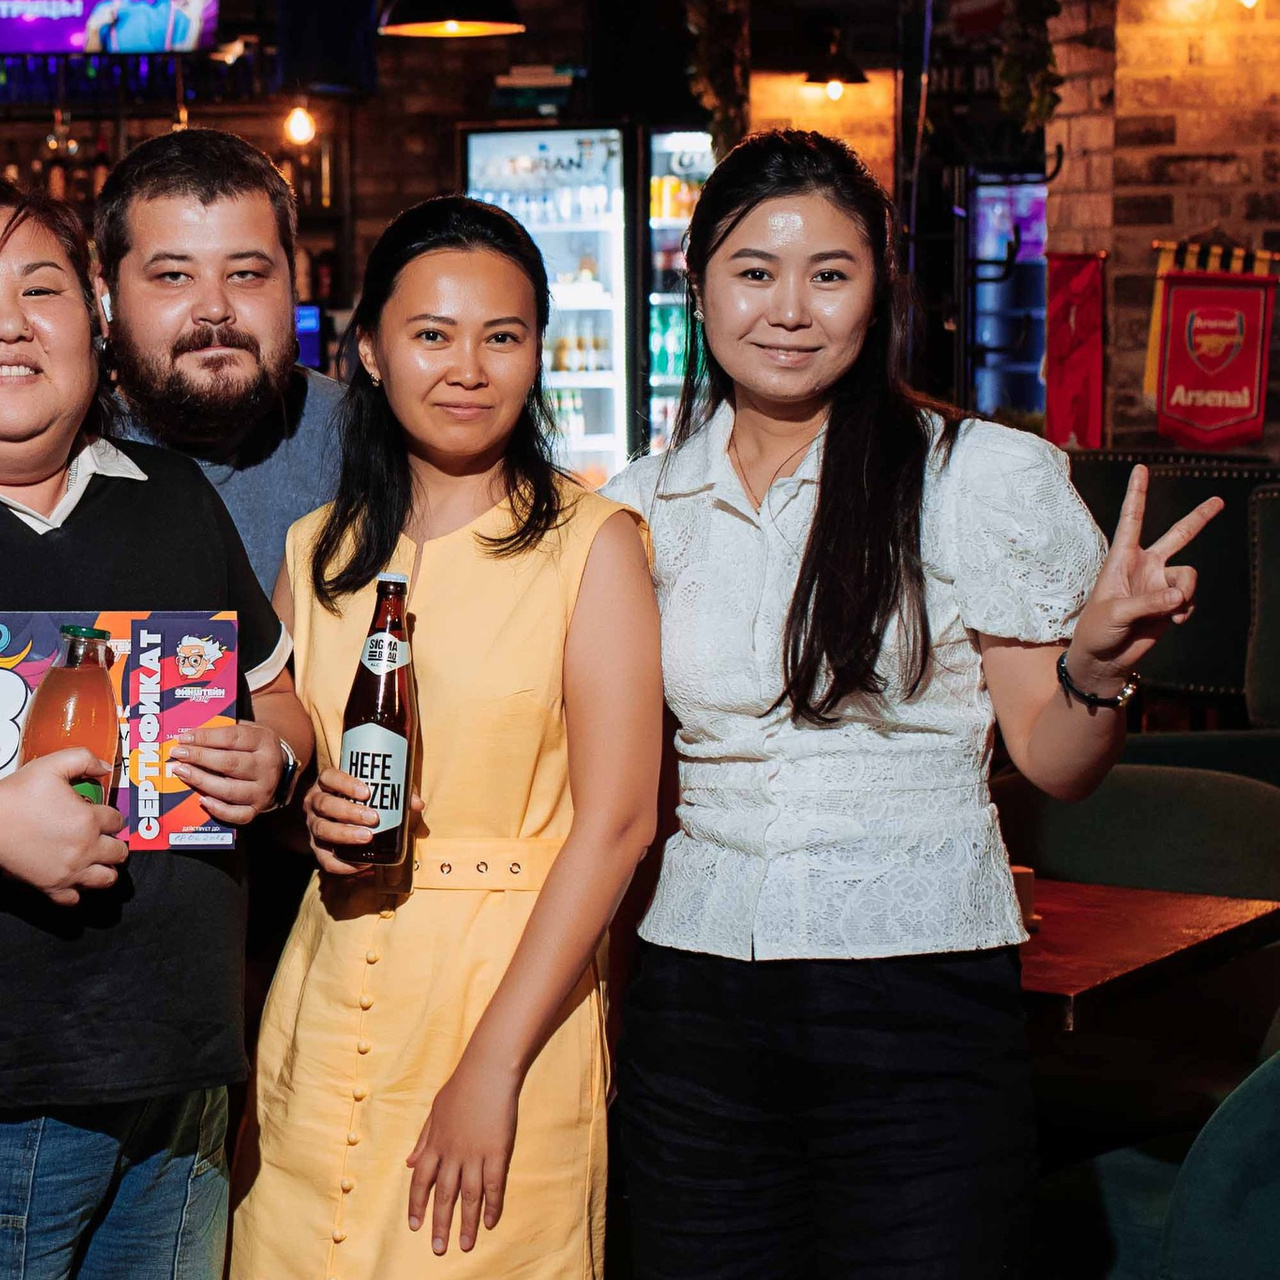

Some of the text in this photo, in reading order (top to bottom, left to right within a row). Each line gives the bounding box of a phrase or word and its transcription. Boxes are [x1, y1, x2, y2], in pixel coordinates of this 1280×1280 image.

[1170, 384, 1251, 409] Arsenal
[138, 629, 162, 840] СЕРТИФИКАТ
[349, 750, 393, 781] HEFE
